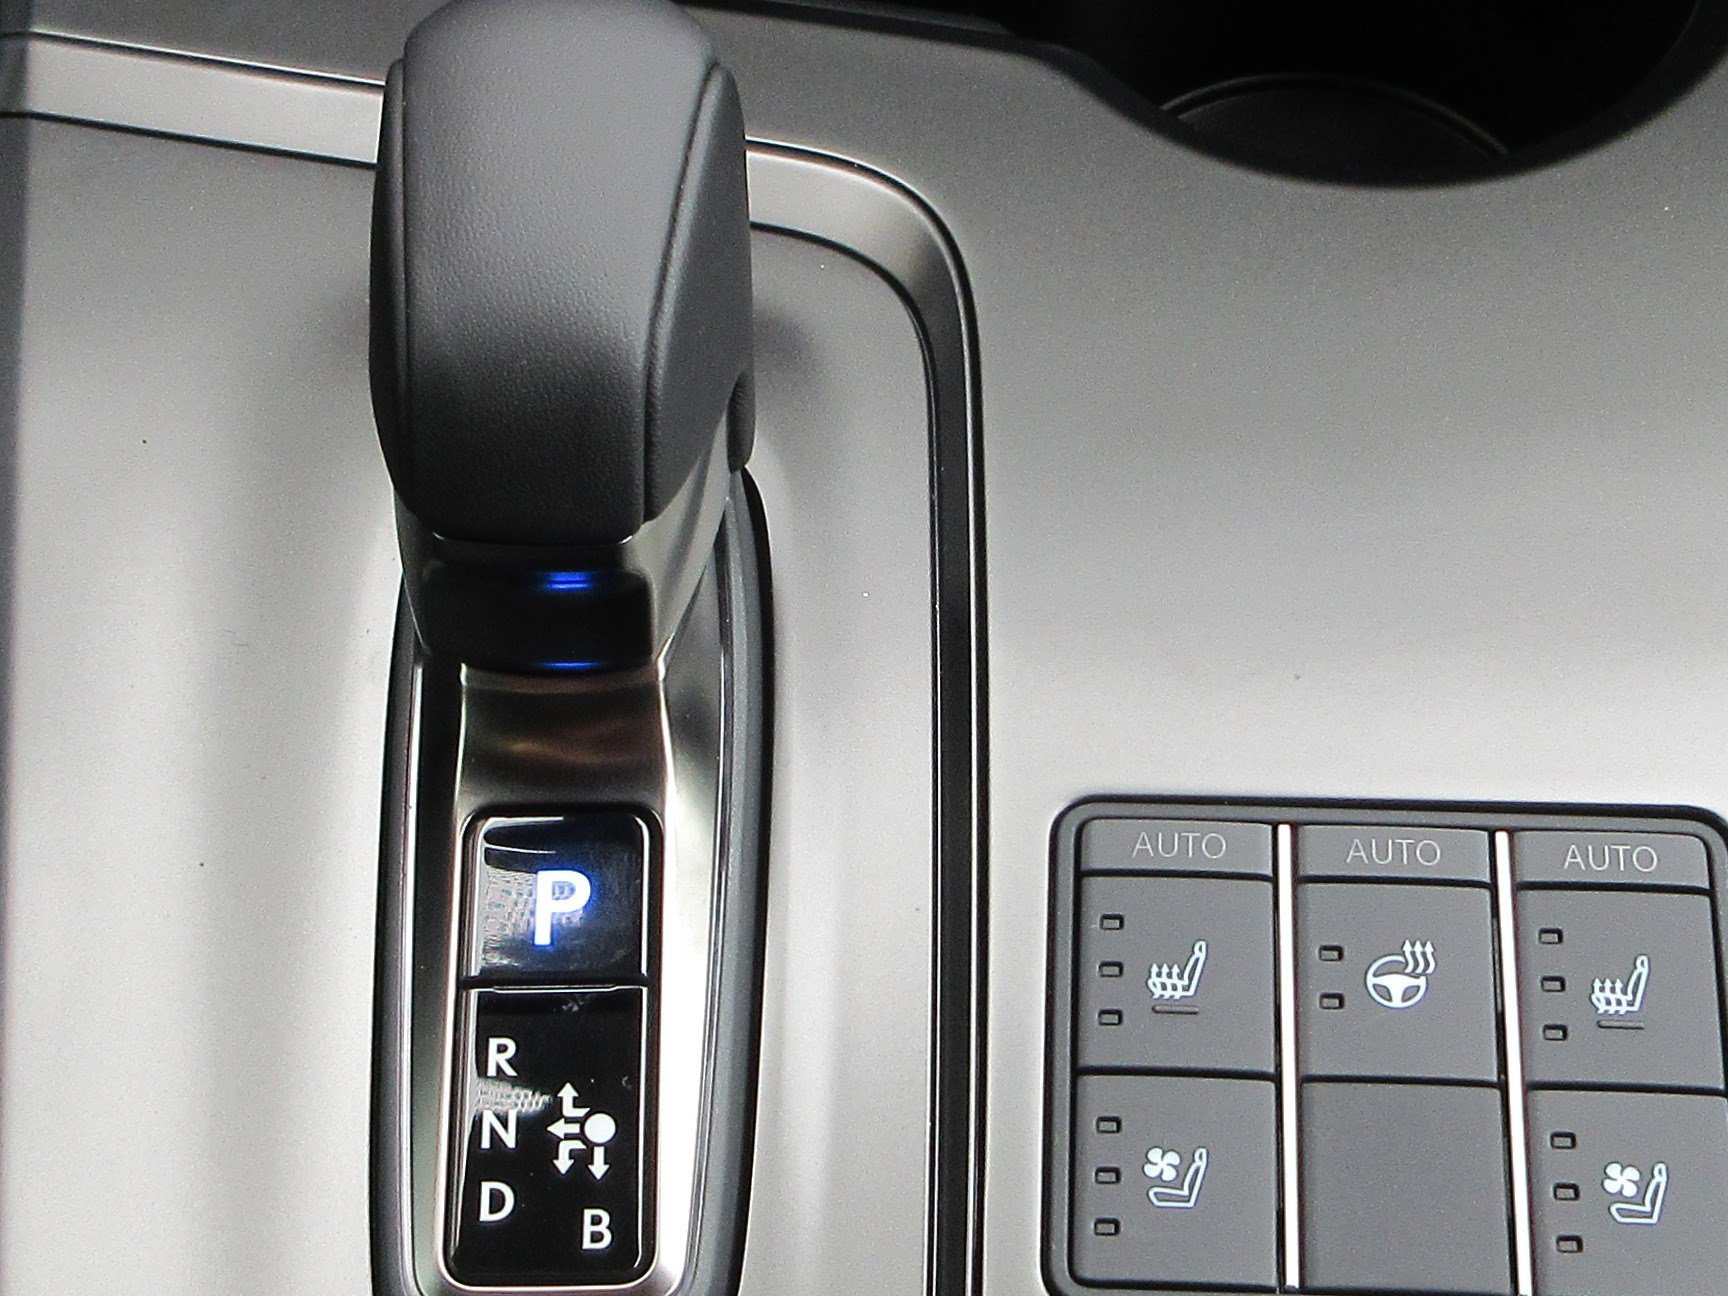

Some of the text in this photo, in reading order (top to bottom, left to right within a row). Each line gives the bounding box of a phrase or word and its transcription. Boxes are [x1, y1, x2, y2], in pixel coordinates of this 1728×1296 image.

[1132, 831, 1227, 861] AUTO
[1346, 838, 1441, 868] AUTO
[1563, 844, 1658, 874] AUTO
[532, 868, 591, 947] P
[486, 1037, 517, 1078] R
[479, 1110, 517, 1150] N
[479, 1182, 515, 1223] D
[581, 1209, 613, 1249] B
